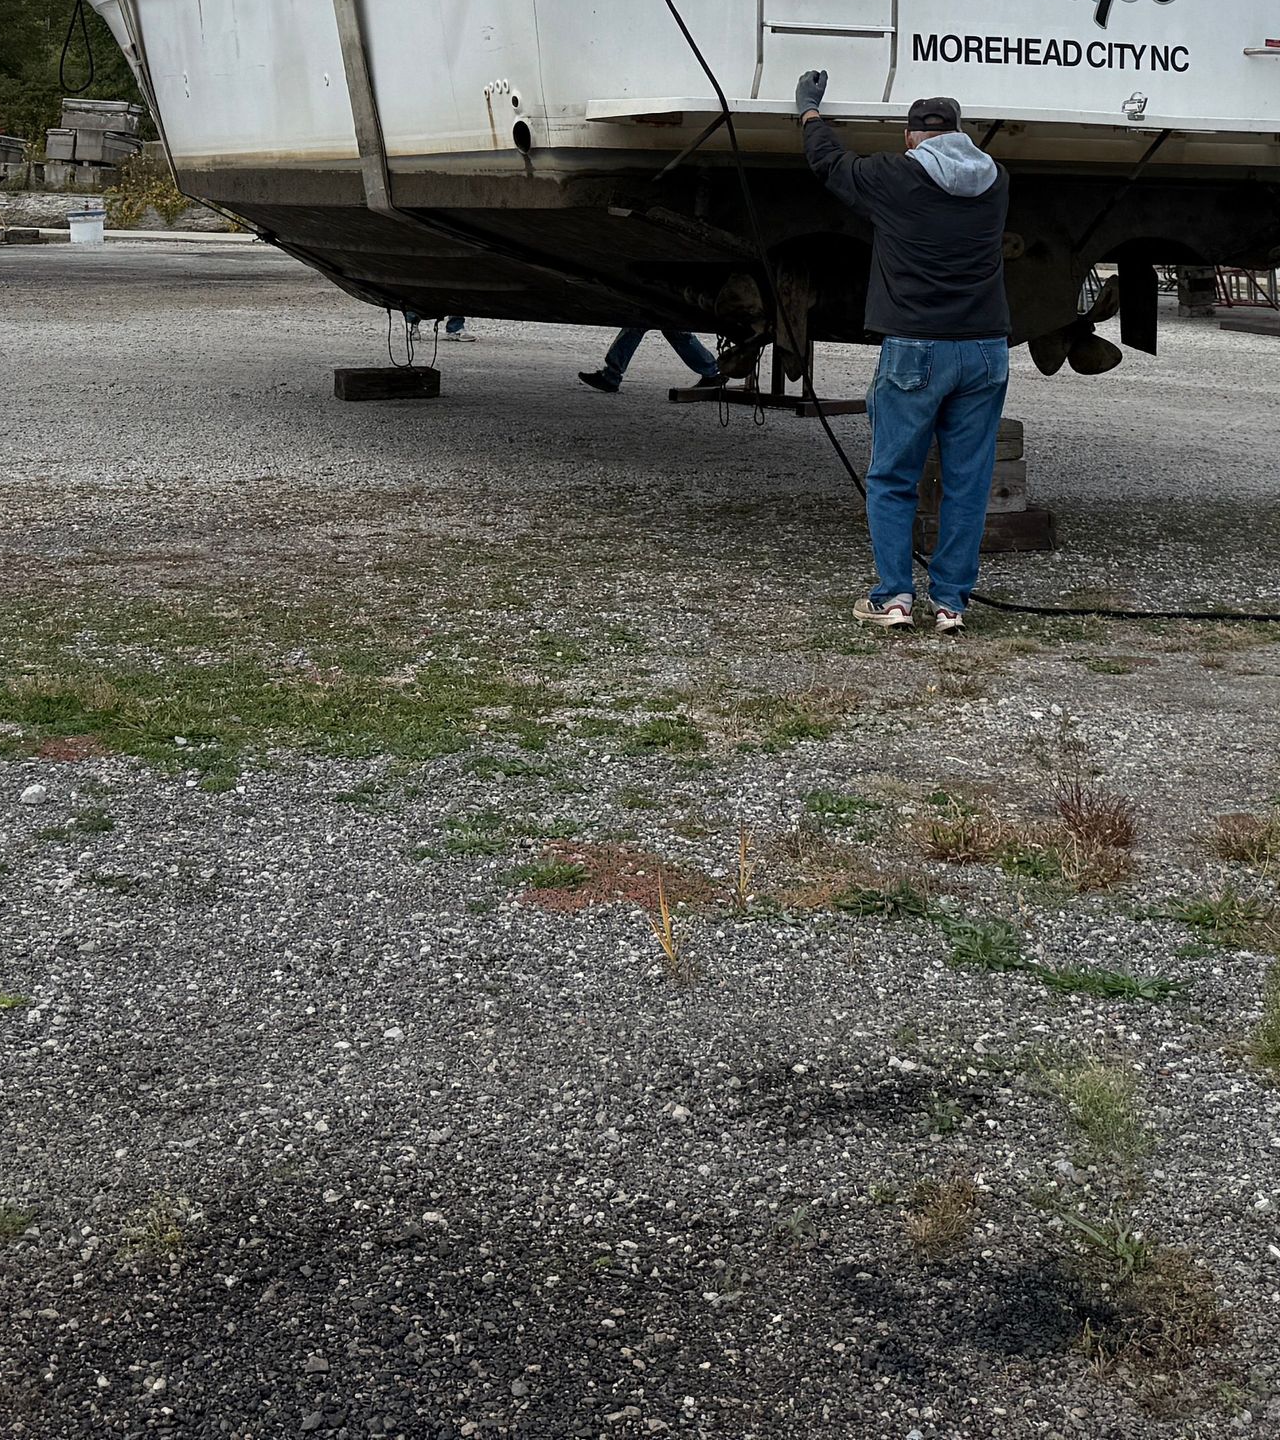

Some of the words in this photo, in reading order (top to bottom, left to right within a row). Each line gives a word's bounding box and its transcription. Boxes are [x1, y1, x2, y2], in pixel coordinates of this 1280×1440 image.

[912, 33, 1082, 67] MOREHEAD
[1086, 42, 1147, 70] CITY
[1151, 44, 1190, 72] NC
